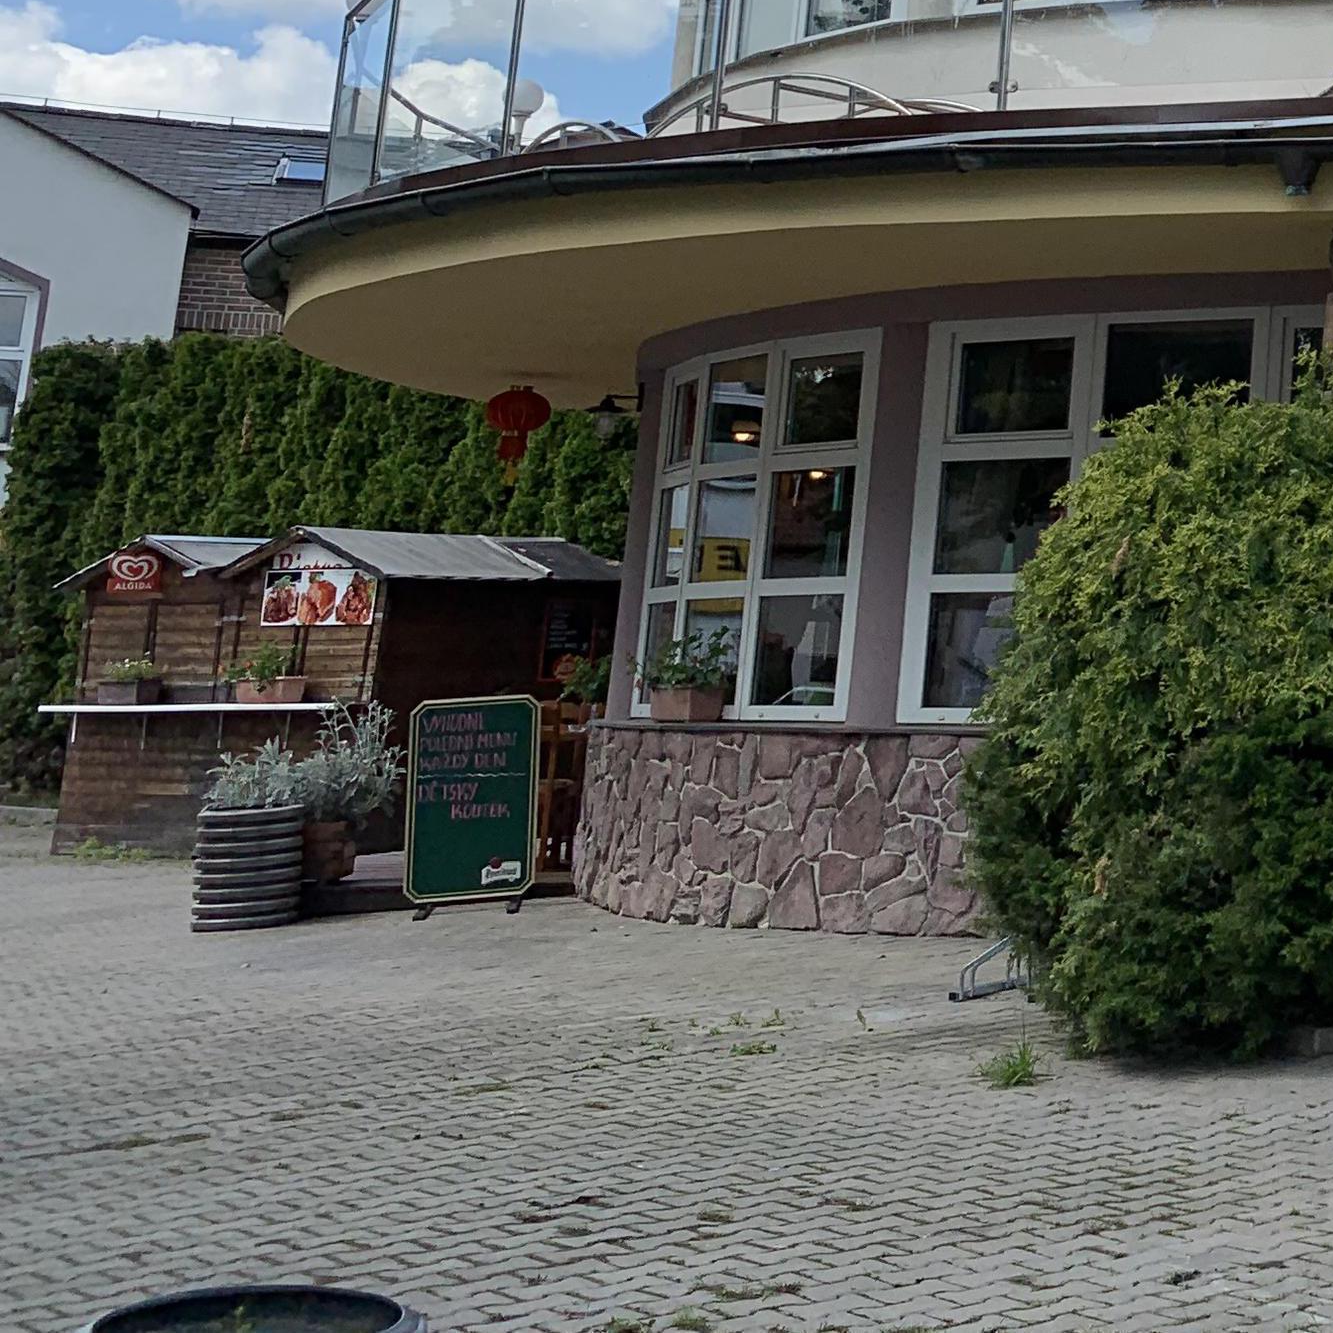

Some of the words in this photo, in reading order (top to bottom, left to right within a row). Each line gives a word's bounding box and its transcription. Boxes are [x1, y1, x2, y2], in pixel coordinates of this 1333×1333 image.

[113, 581, 152, 591] ALGIDA
[475, 751, 507, 769] DEN
[451, 803, 511, 820] KOUTEK
